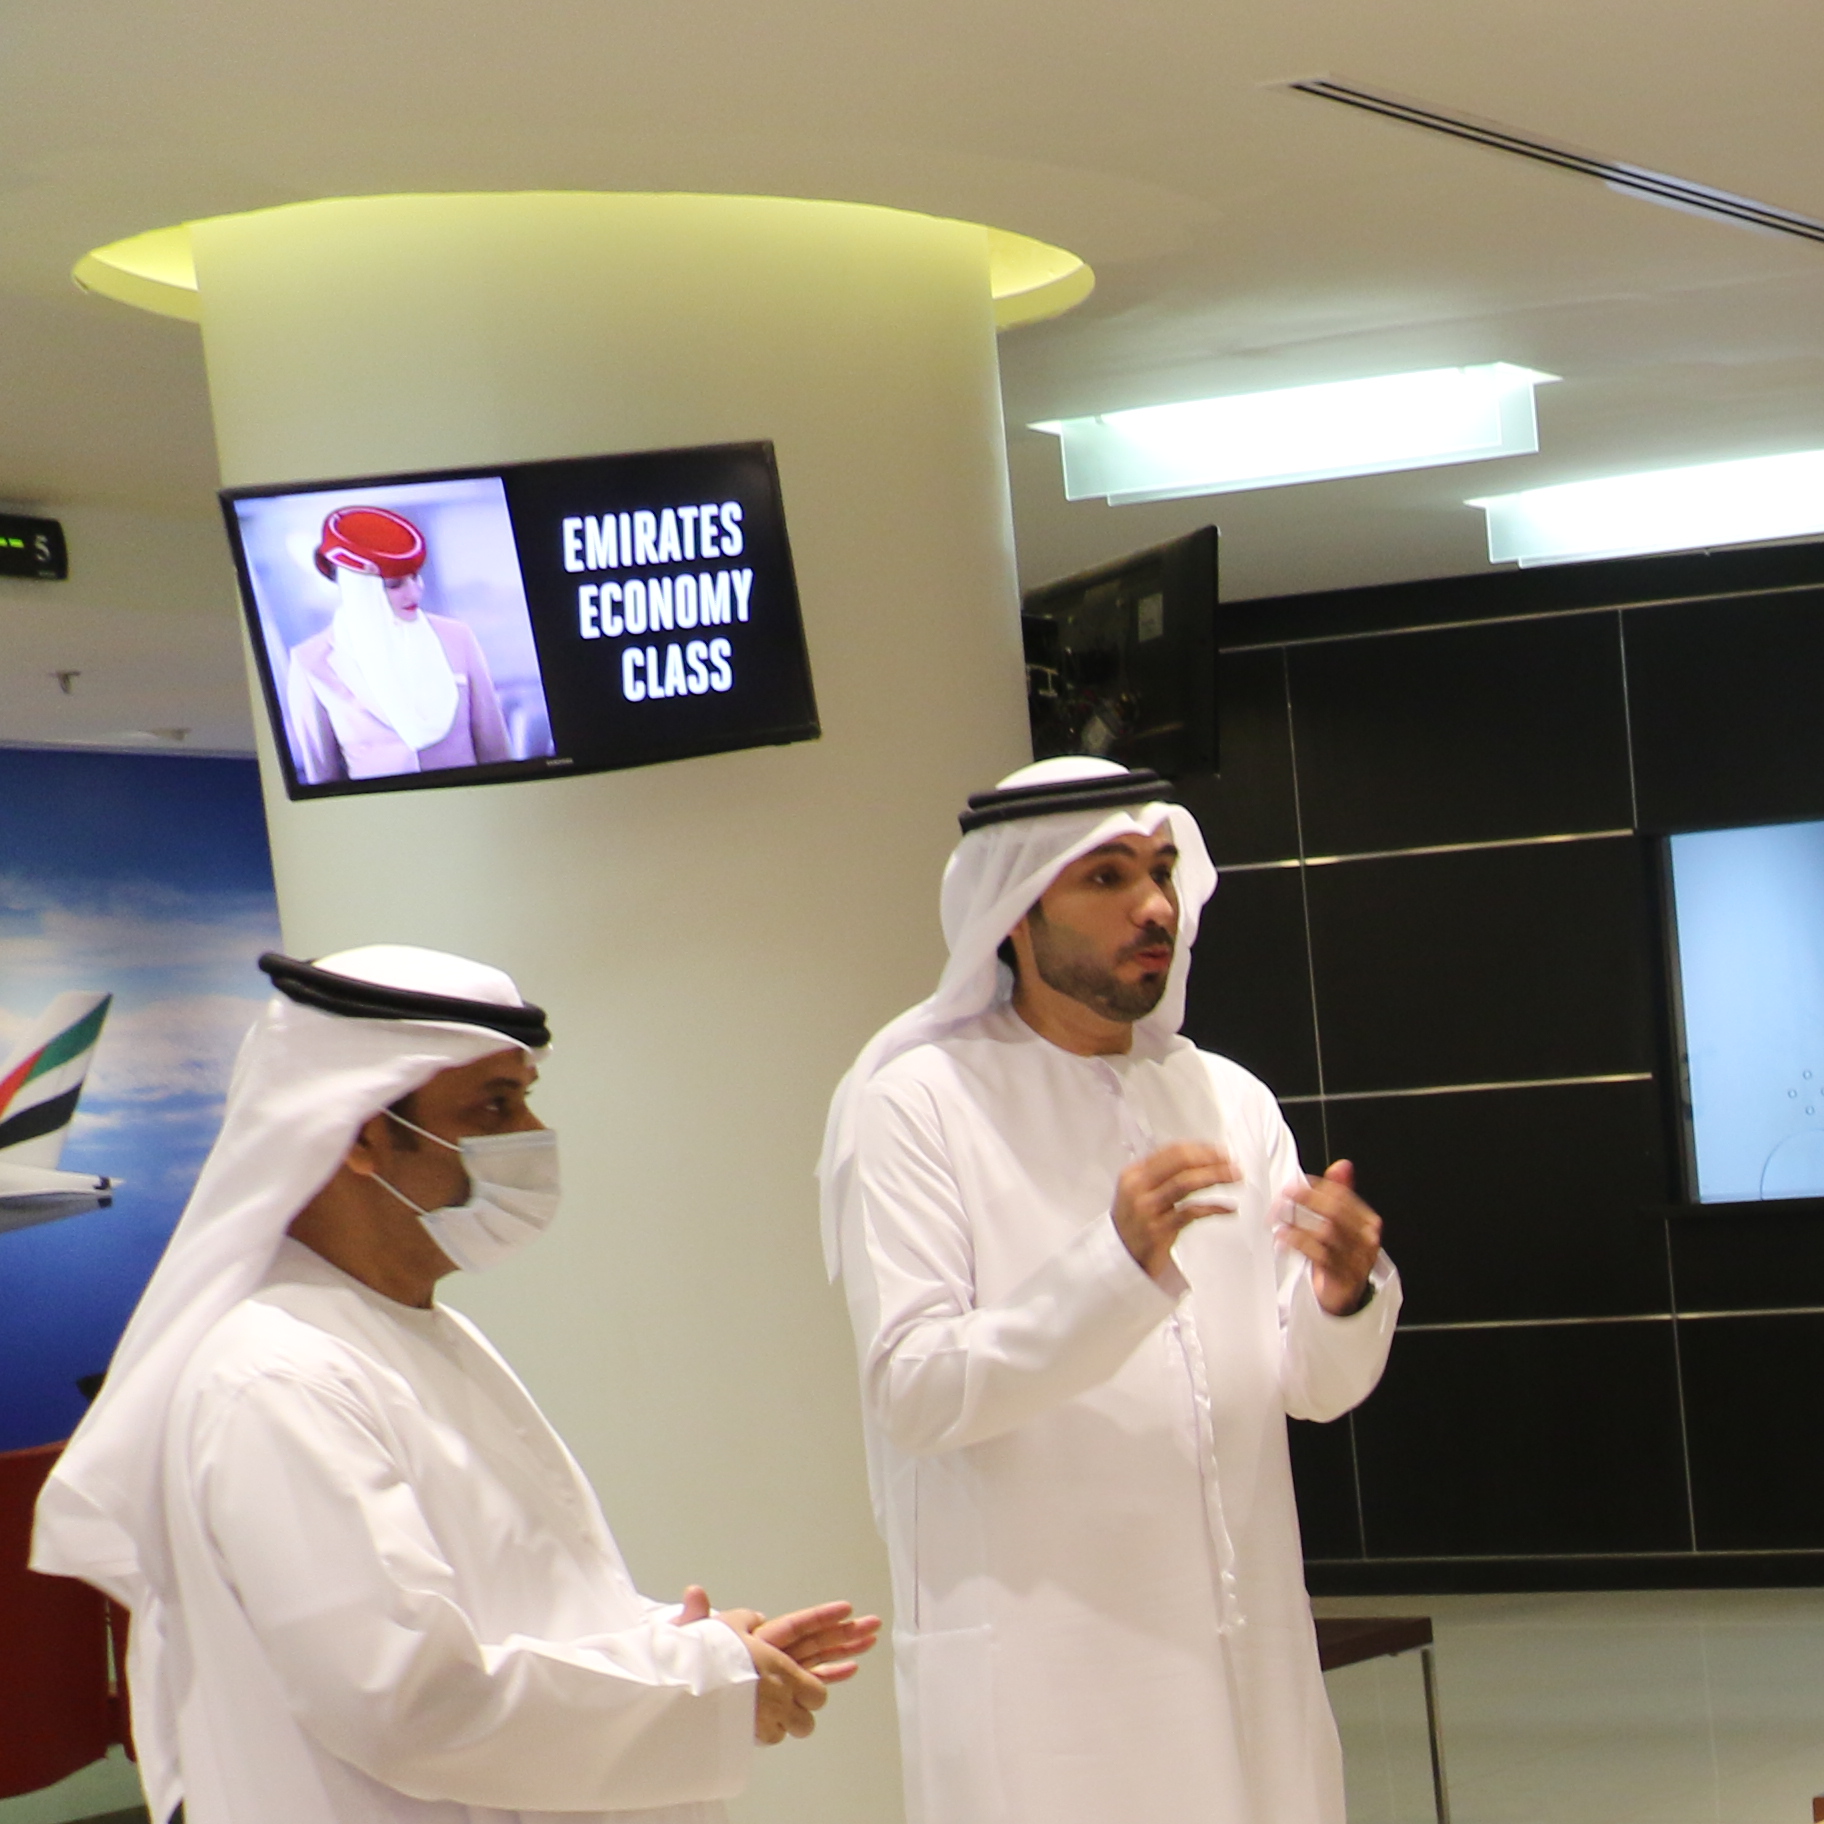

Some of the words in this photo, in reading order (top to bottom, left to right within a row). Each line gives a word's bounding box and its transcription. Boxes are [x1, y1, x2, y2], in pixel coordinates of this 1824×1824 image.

[562, 501, 744, 573] EMIRATES
[578, 568, 753, 639] ECONOMY
[621, 637, 733, 702] CLASS
